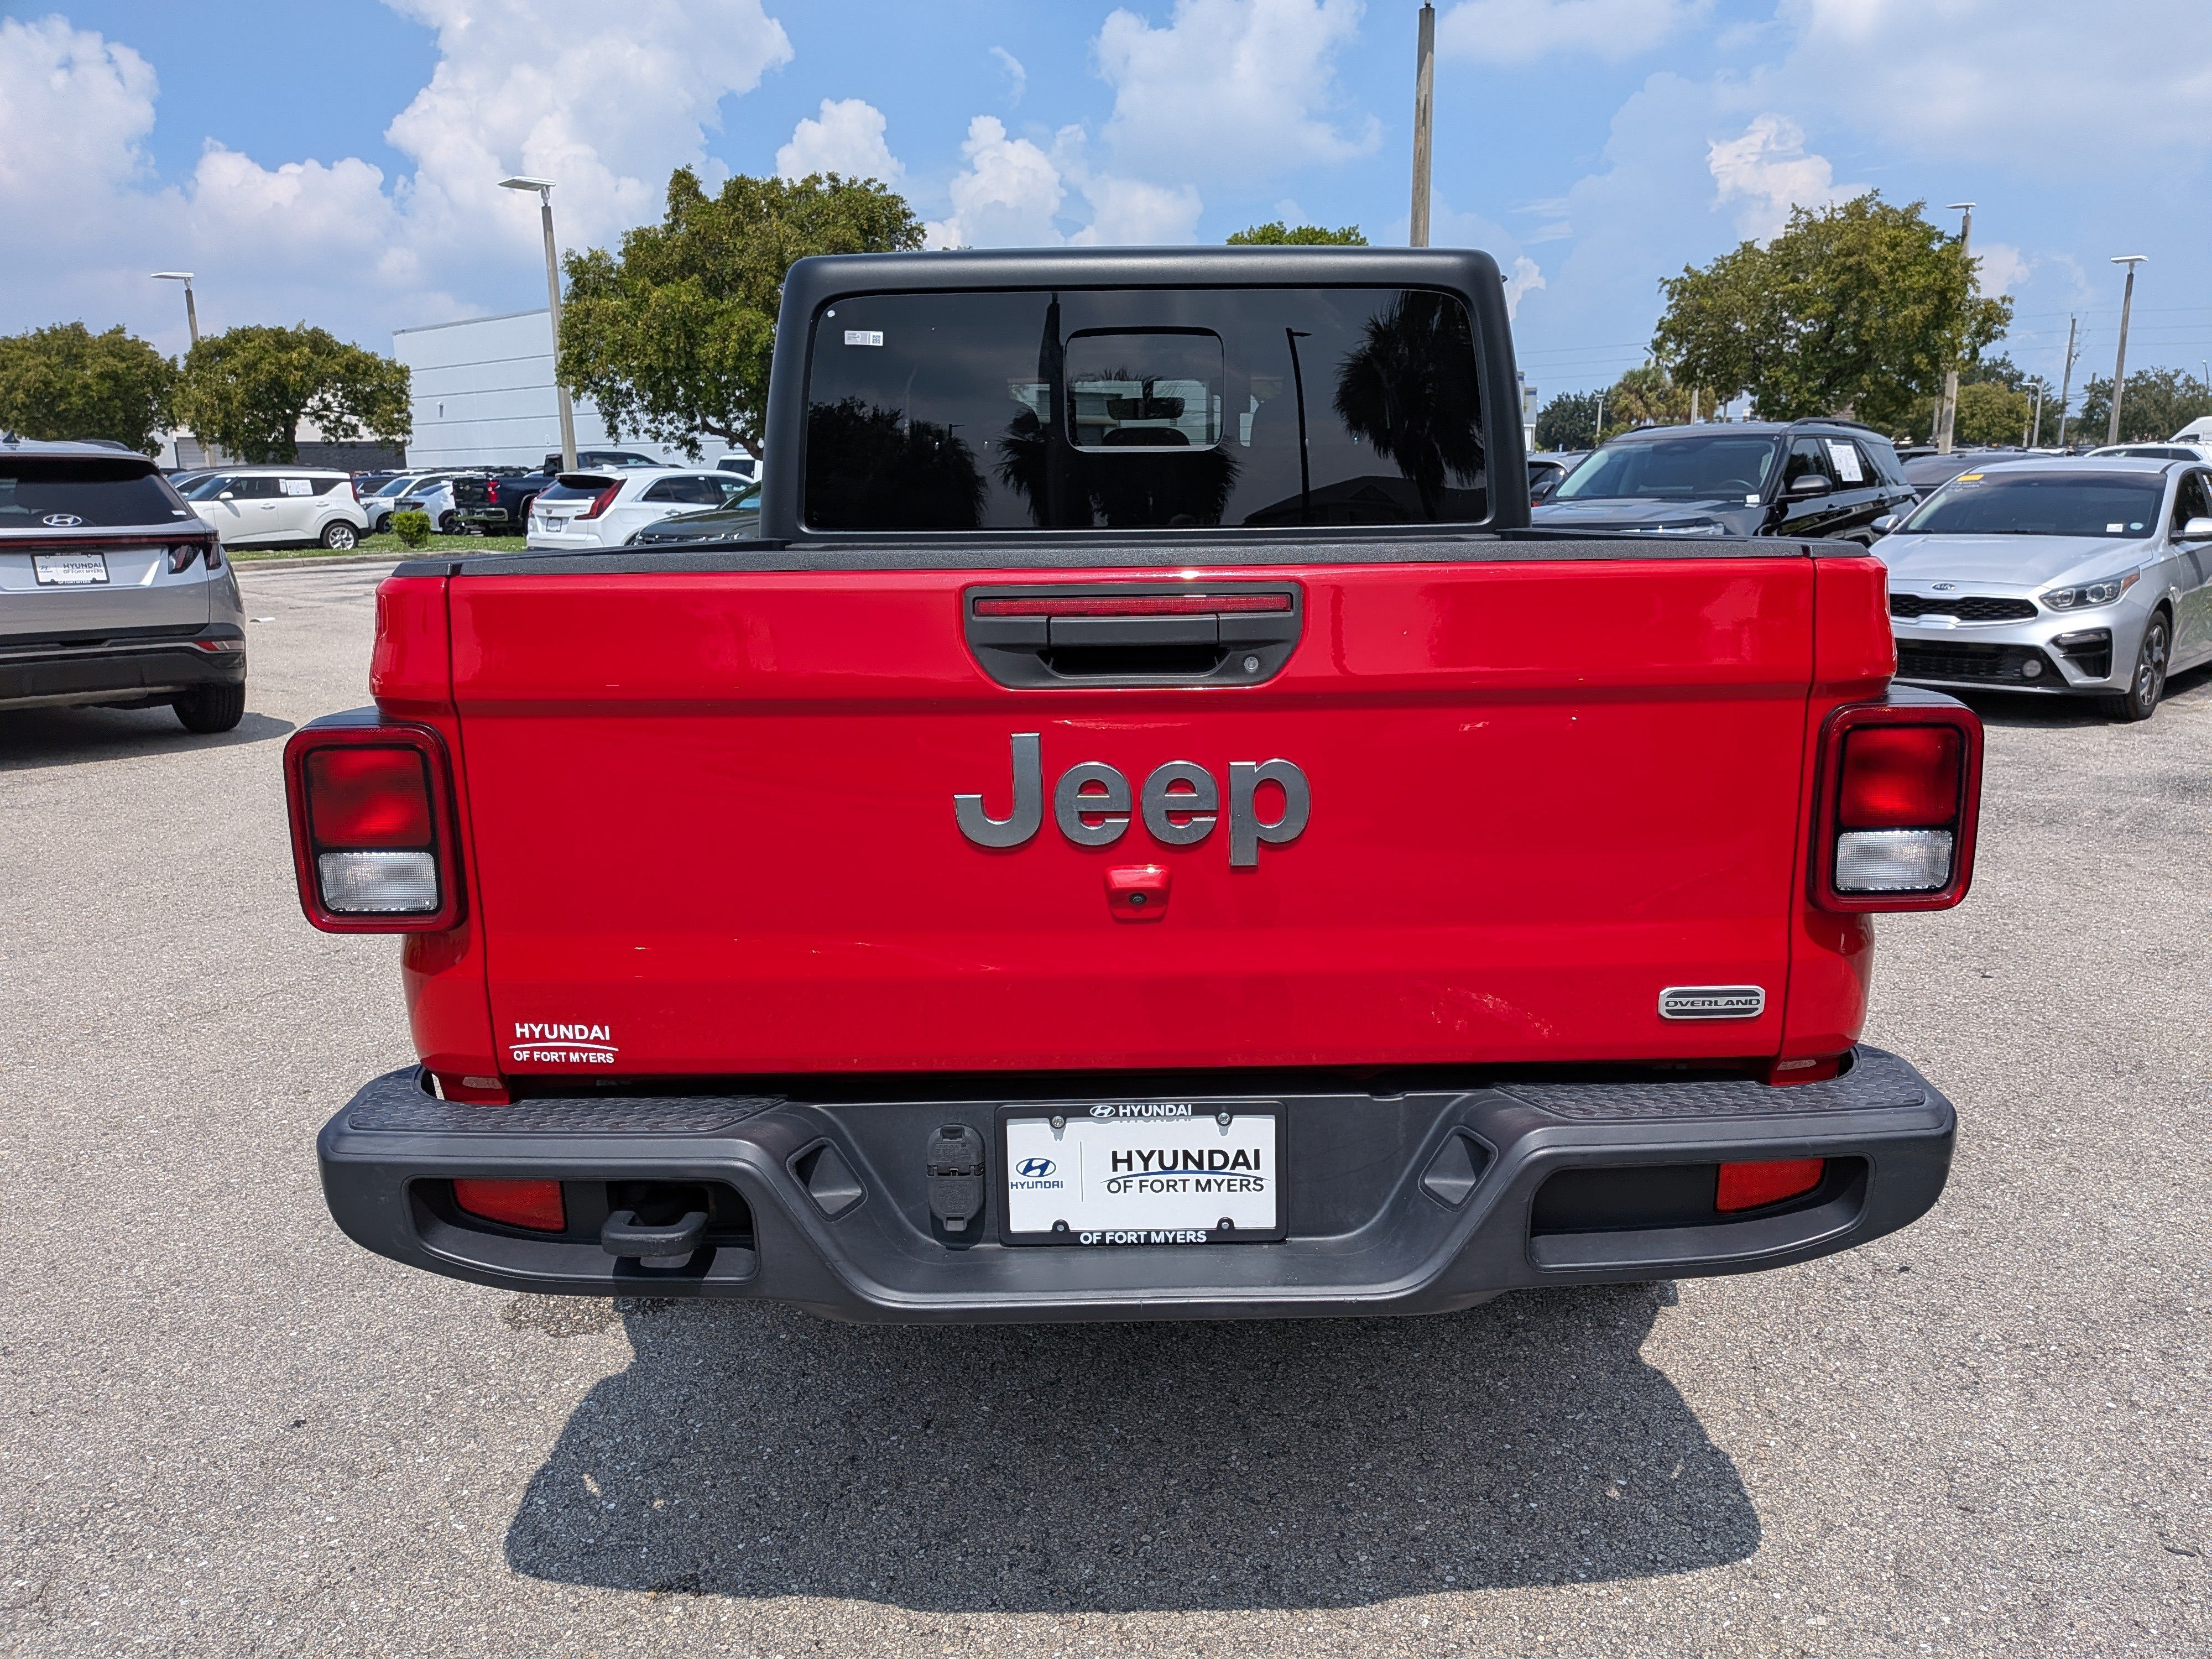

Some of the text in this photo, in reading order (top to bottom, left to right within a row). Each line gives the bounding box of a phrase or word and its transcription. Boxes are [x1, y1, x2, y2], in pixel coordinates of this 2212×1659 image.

[953, 732, 1311, 868] Jeep
[1665, 999, 1761, 1008] OVERLAND
[515, 1022, 610, 1040] HYUNDAI
[513, 1050, 614, 1063] OF FORT MYERS
[1119, 1104, 1192, 1117] HYUNDAI
[1112, 1149, 1260, 1172] HYUNDAI
[1011, 1180, 1063, 1189] HYUNDAI
[1107, 1177, 1264, 1193] OF FORT MYERS
[1080, 1231, 1207, 1244] OF FORT MYERS
